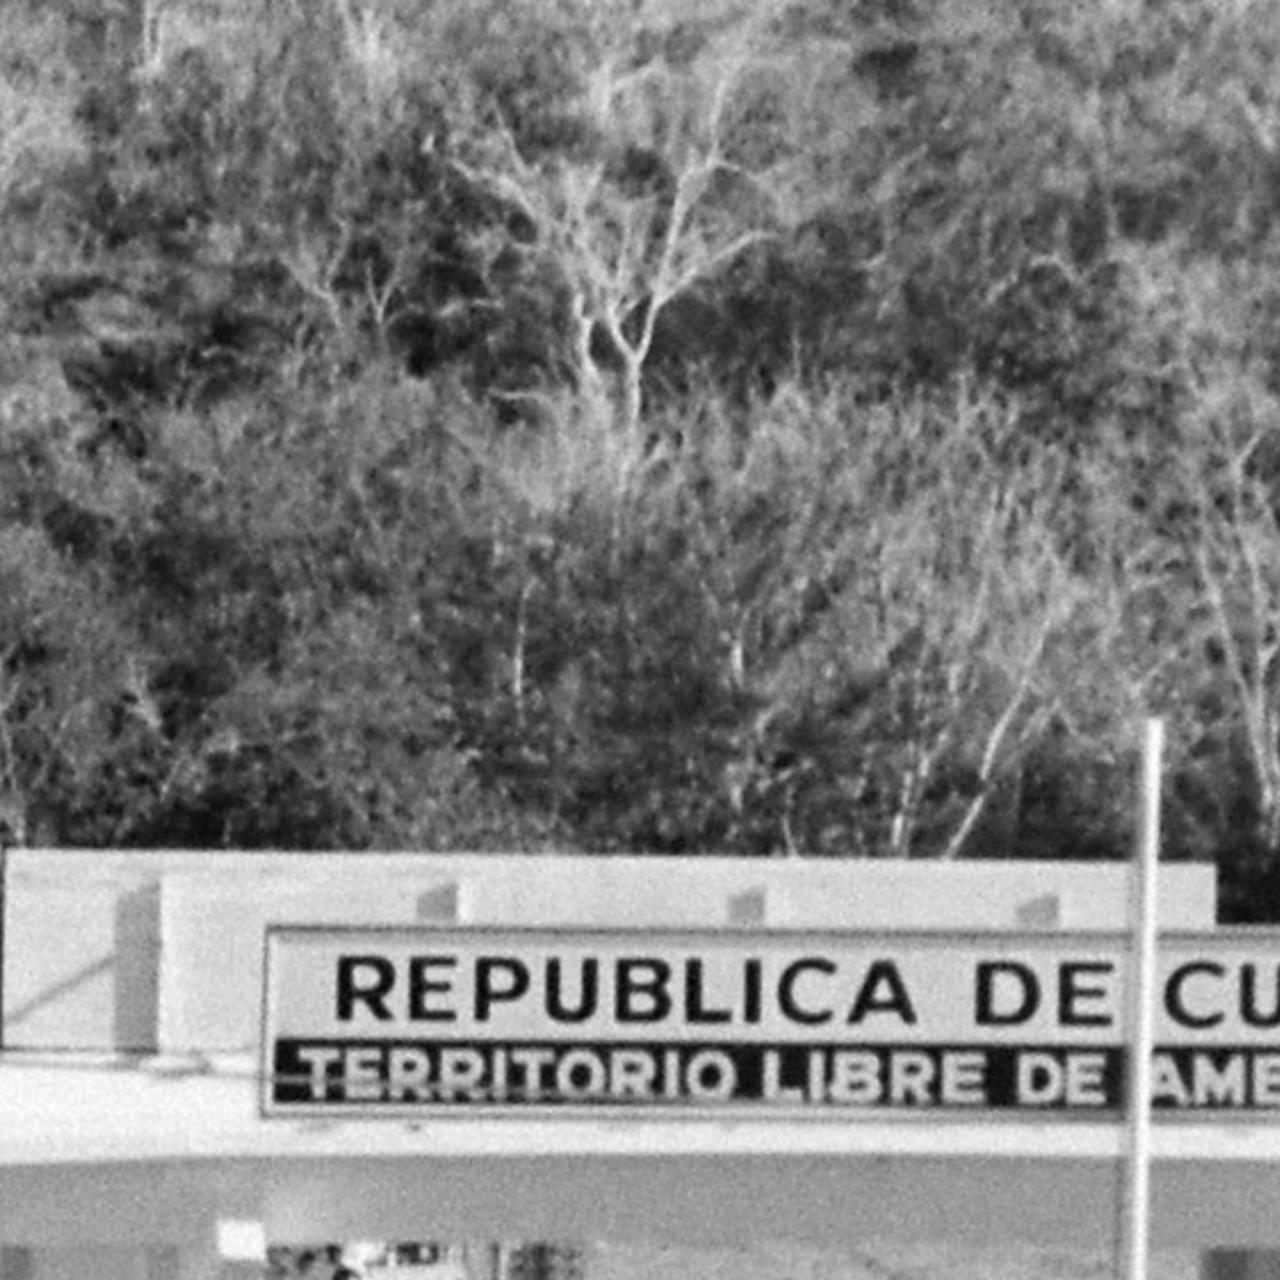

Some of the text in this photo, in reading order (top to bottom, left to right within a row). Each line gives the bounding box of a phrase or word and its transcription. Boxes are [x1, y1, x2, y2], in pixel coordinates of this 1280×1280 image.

[336, 955, 1280, 1029] REPUBLICA DE CU
[298, 1046, 1280, 1106] TERRITORIO LIBRE DE AME
